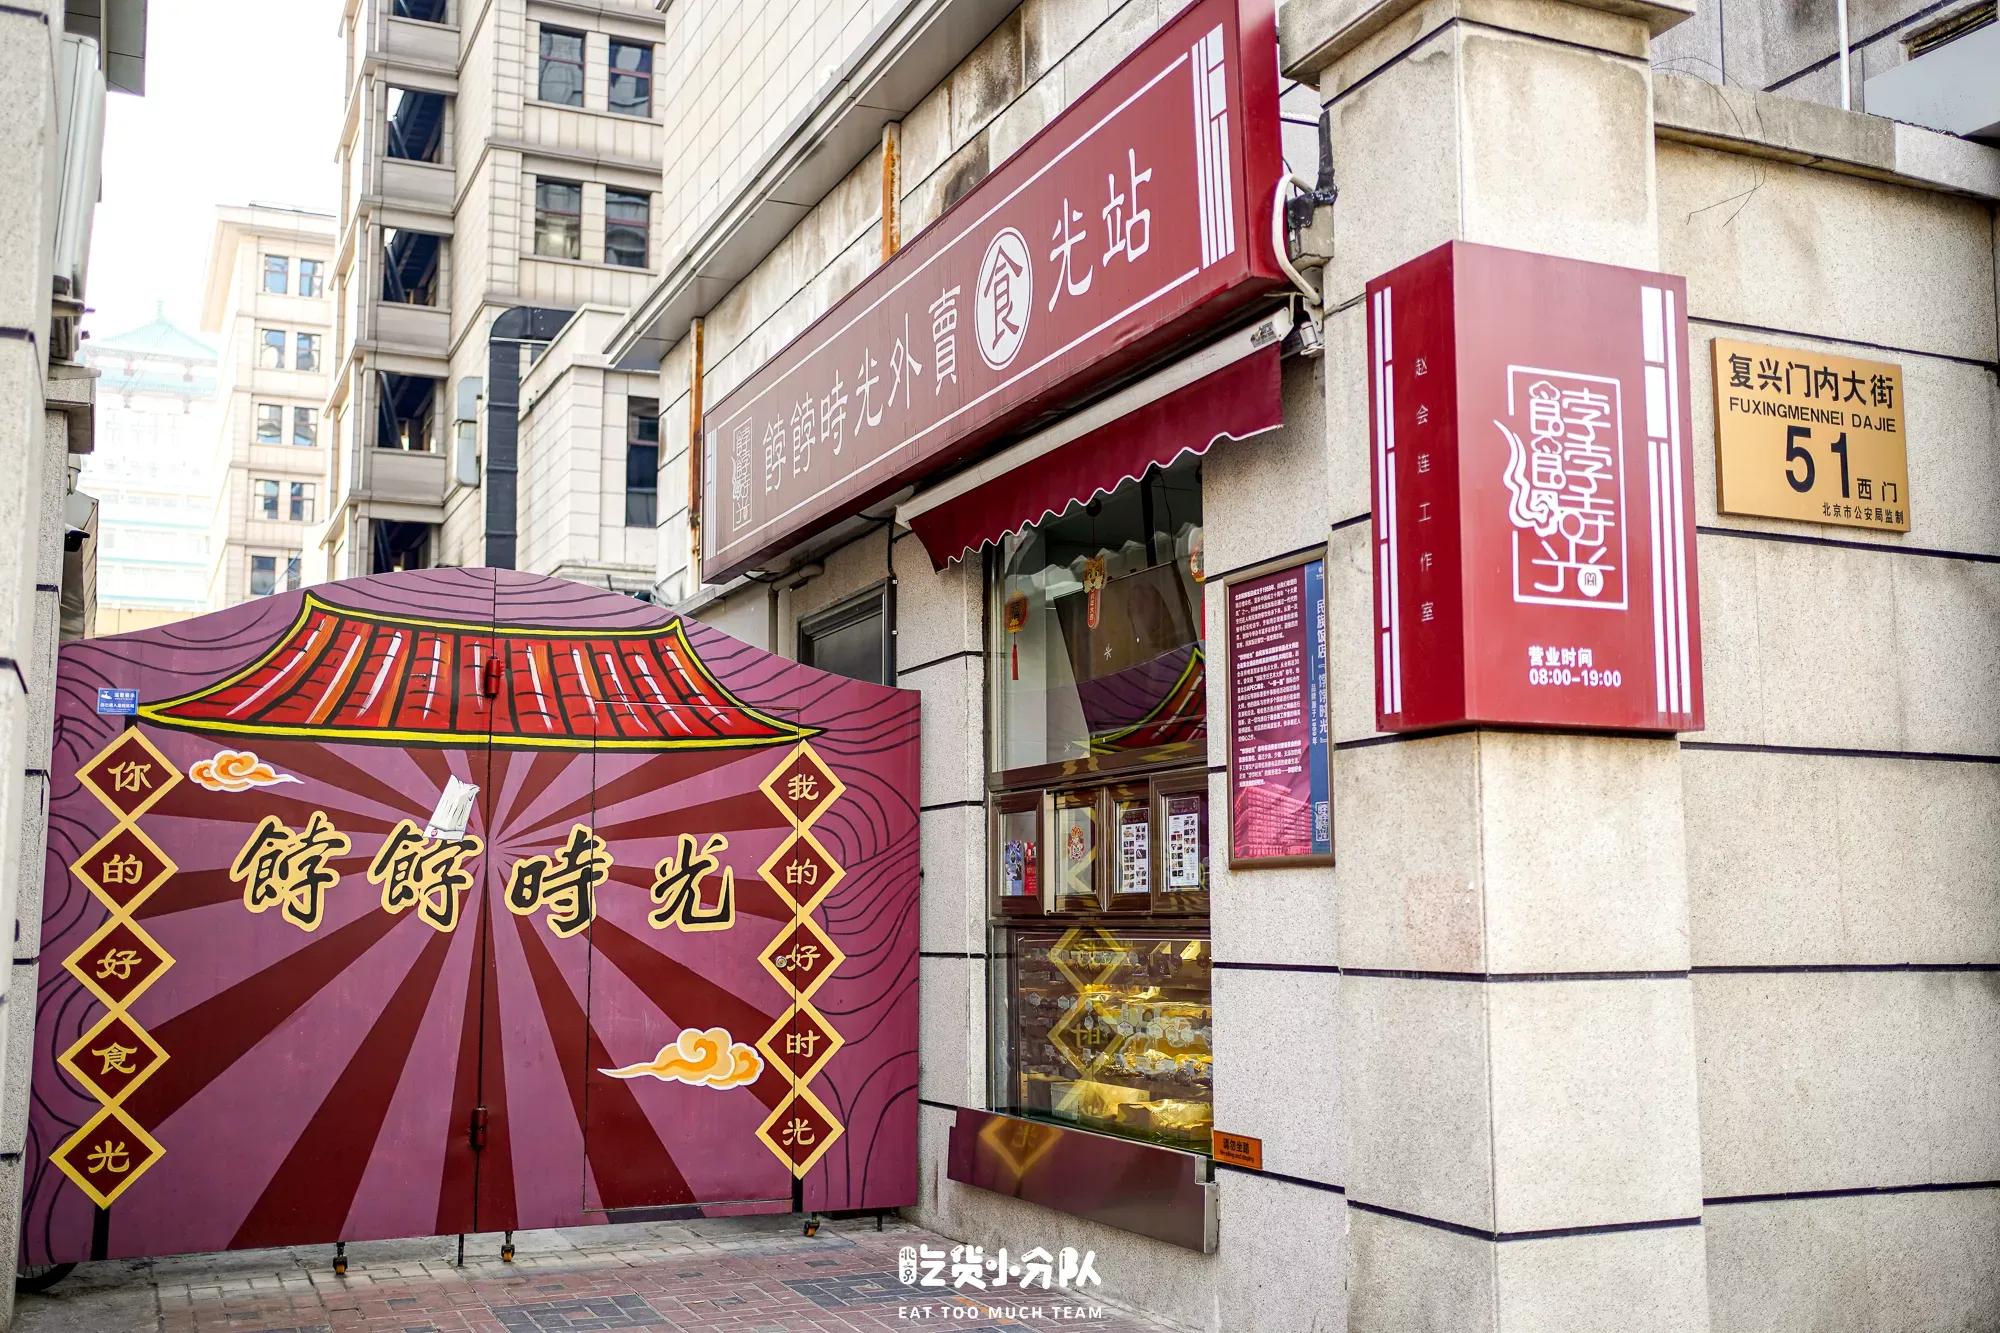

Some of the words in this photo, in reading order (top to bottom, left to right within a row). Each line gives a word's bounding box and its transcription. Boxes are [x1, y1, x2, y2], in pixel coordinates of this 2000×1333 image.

[1728, 353, 1894, 409] 复兴门内大街
[1730, 397, 1844, 426] FUXINGMENNEI
[1852, 413, 1896, 432] DAJIE
[1415, 358, 1434, 622] 赵会连工作室
[1785, 424, 1850, 498] 51
[1857, 478, 1897, 503] 西门
[1822, 502, 1904, 525] 北京市公安局监制
[1528, 646, 1593, 668] 营业时间
[1529, 667, 1622, 688] 08:00-19:00
[87, 761, 152, 1174] 你的好食光
[782, 774, 820, 1146] 我的好时光
